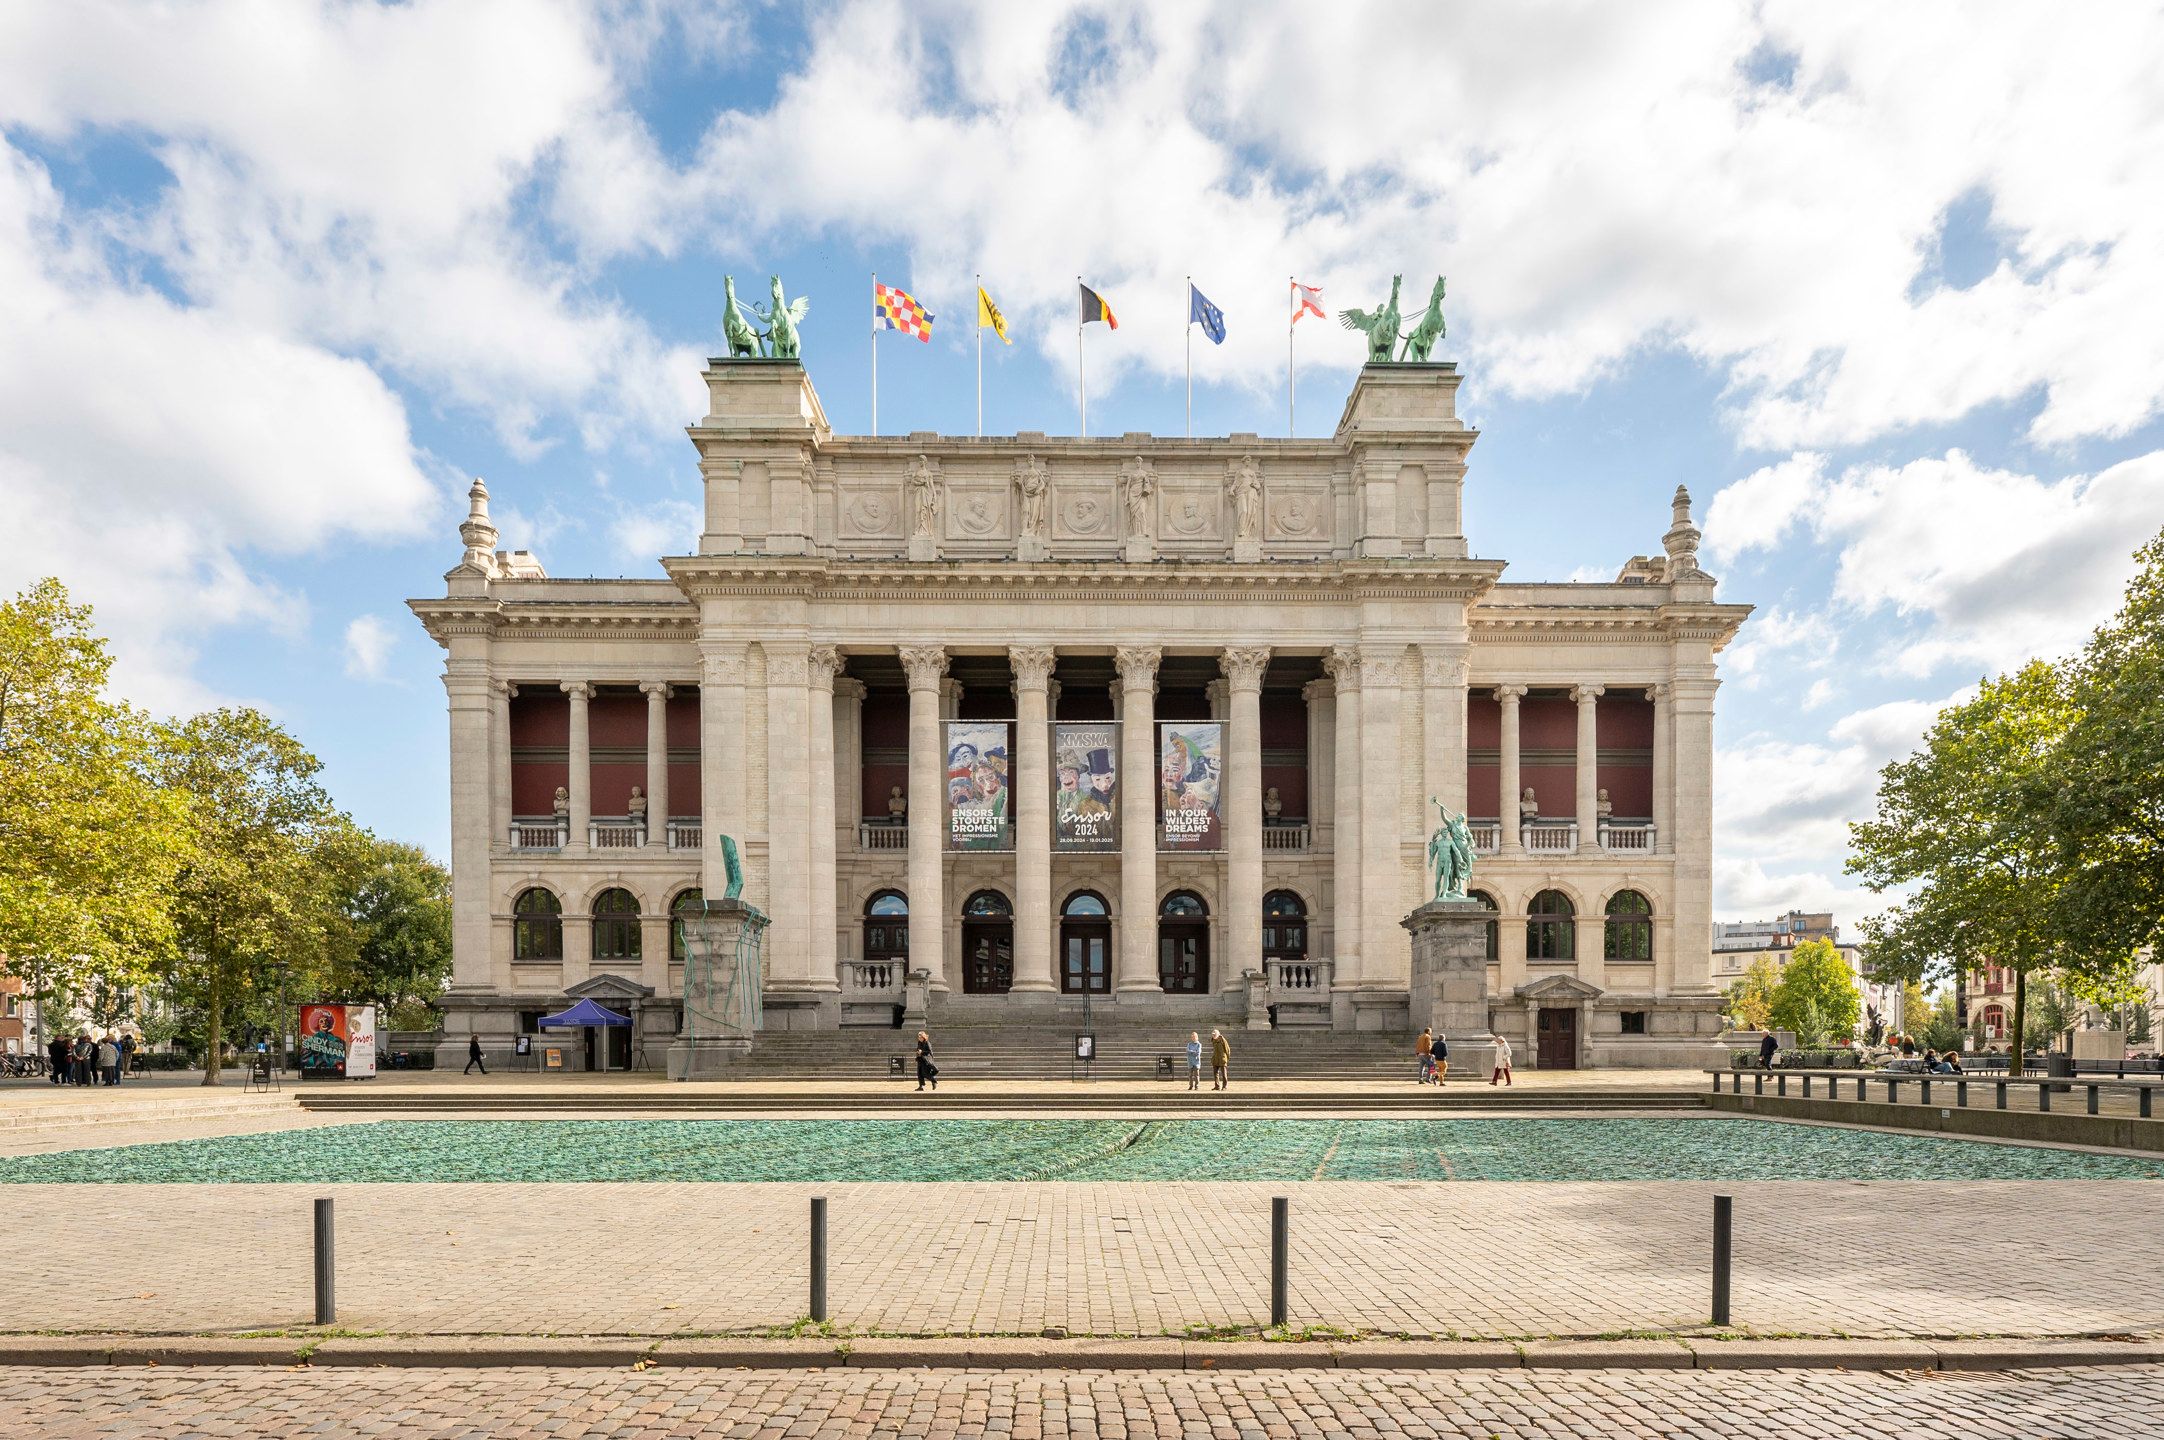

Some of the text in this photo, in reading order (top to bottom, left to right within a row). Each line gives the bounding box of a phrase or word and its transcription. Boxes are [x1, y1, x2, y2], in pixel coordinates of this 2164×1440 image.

[1060, 732, 1111, 747] KMSKA
[1061, 807, 1112, 823] Ensor
[1075, 824, 1098, 835] 2024
[302, 1034, 328, 1046] CINDY
[302, 1040, 345, 1057] SHERMAN
